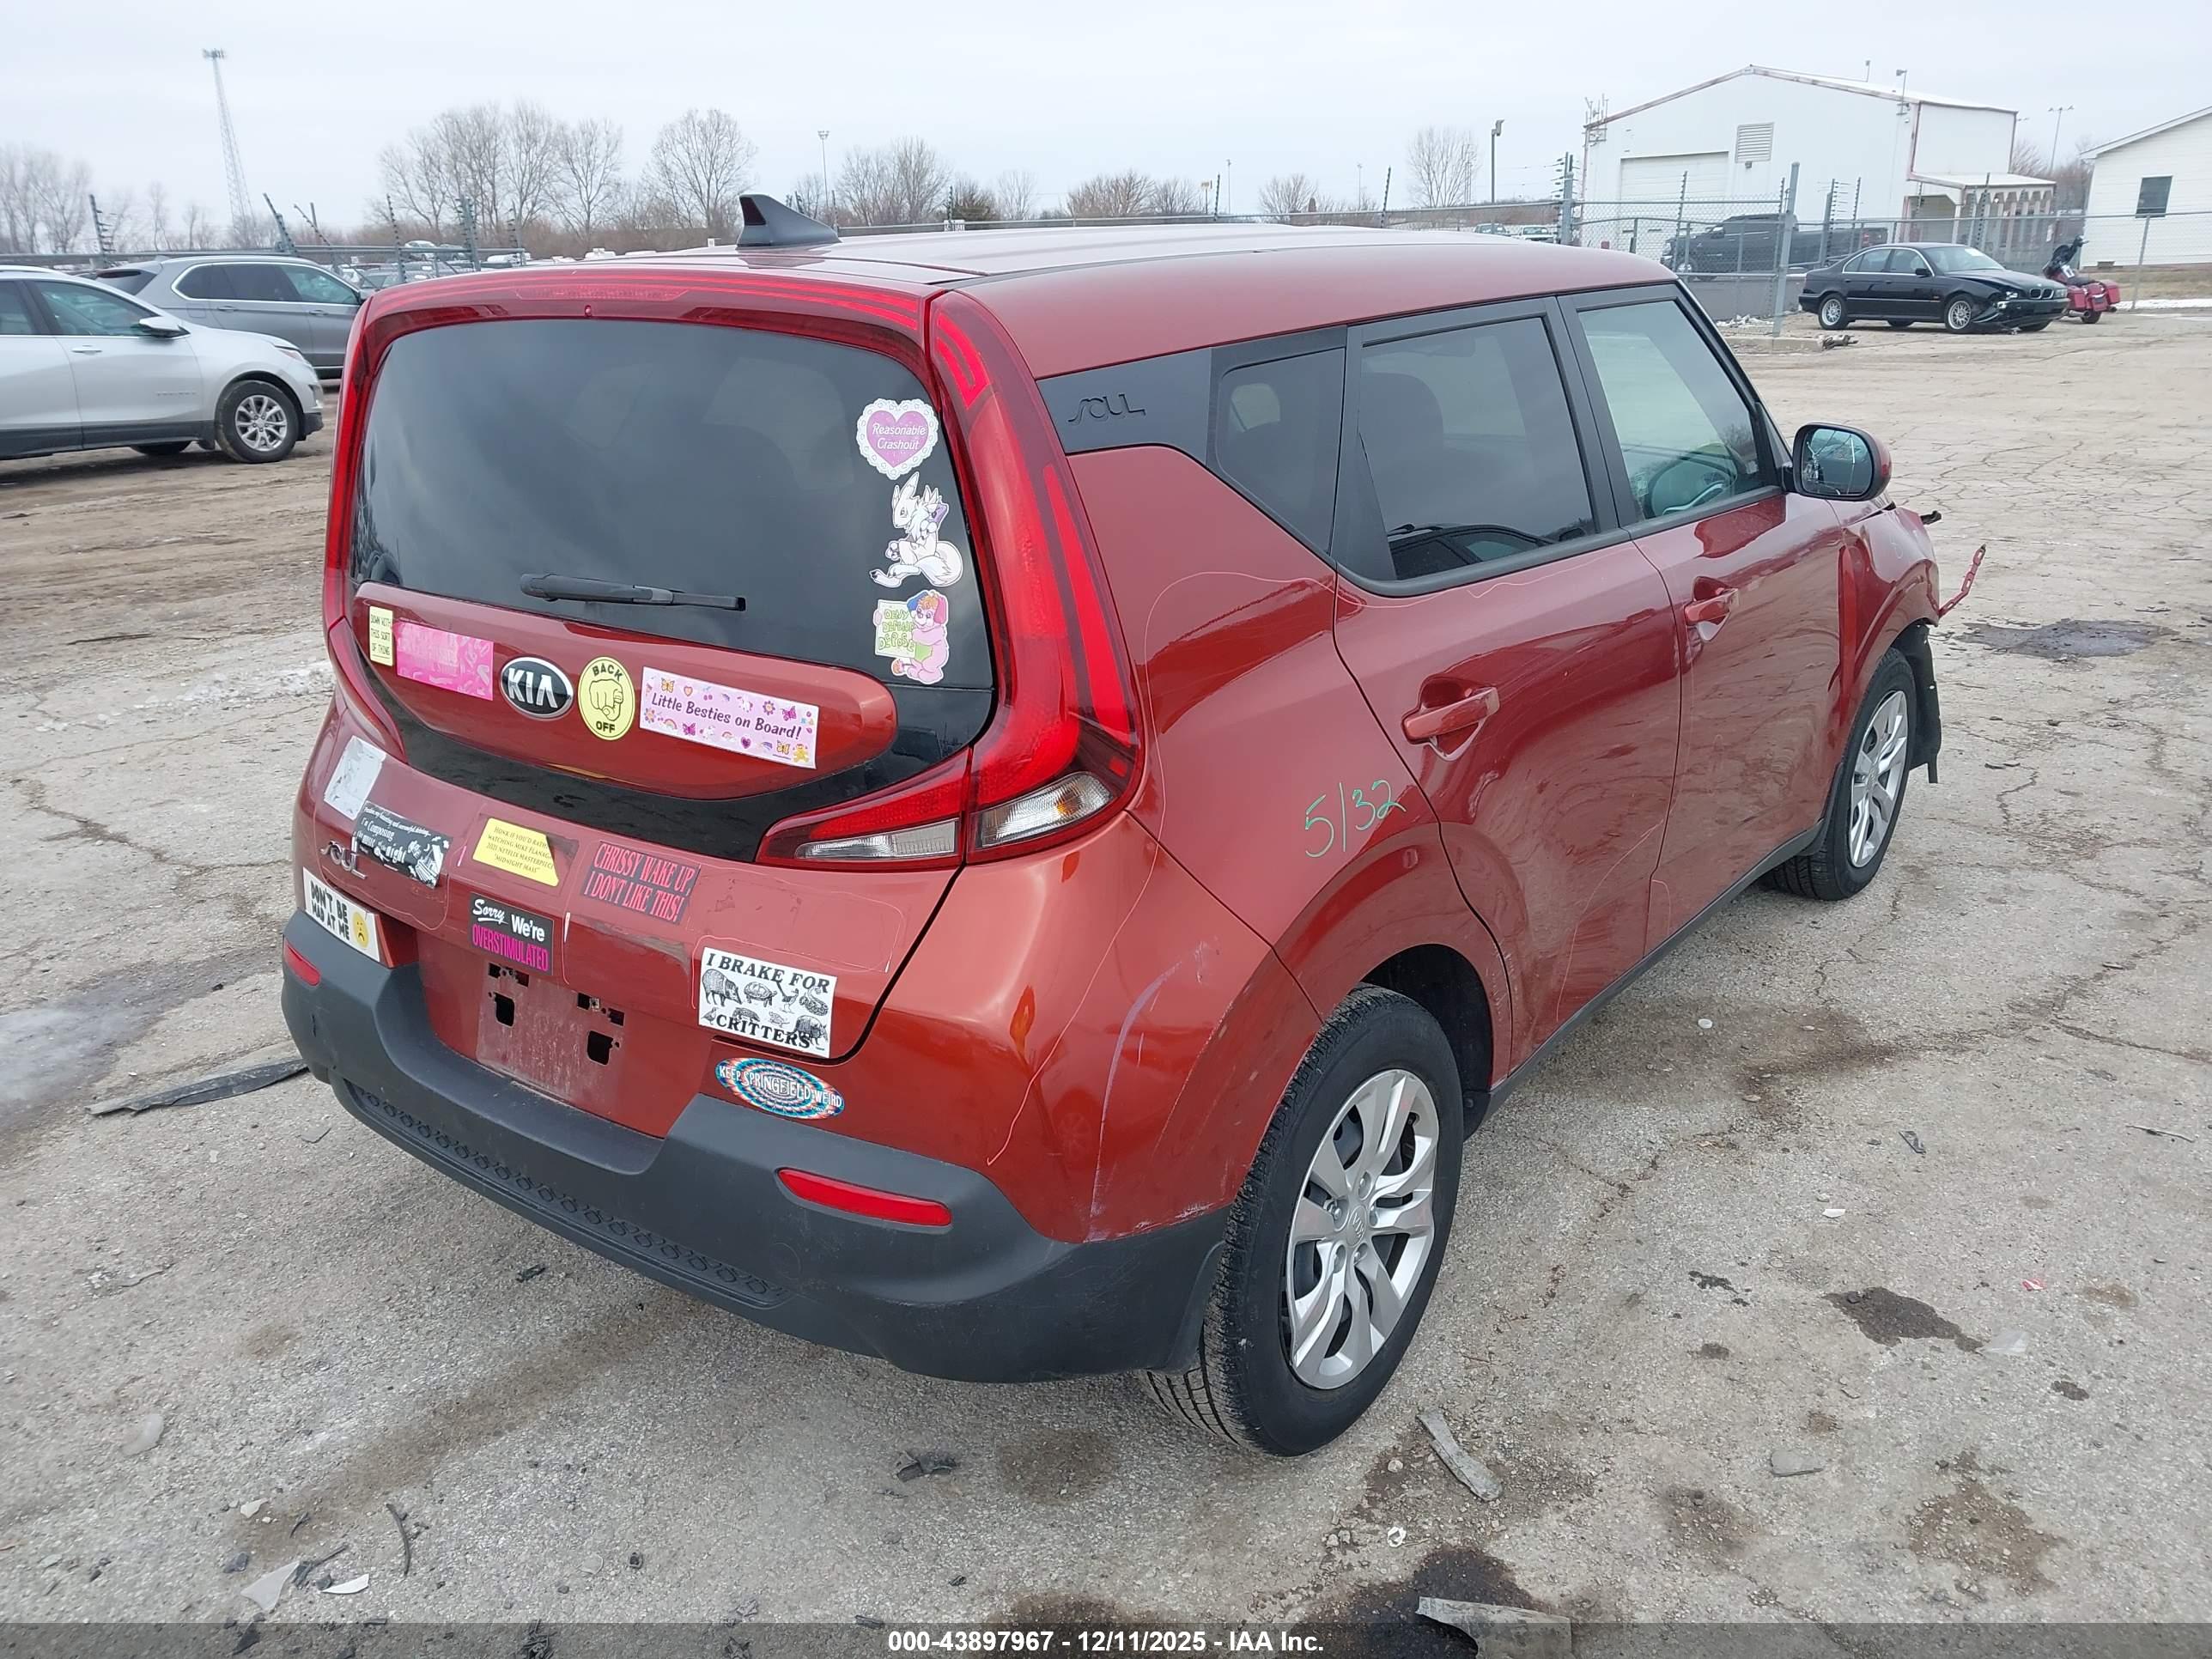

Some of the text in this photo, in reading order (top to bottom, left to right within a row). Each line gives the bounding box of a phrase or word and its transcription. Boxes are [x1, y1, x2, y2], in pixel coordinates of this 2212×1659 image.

[1067, 393, 1146, 423] SOUL
[872, 422, 927, 435] Reasonable
[877, 437, 920, 450] Crashout
[884, 609, 909, 620] DENY
[878, 632, 915, 652] DEPOSE
[507, 667, 558, 708] KIA
[592, 662, 623, 682] BACK
[596, 720, 616, 733] OFF
[651, 692, 802, 740] Little Besties on Board!
[368, 820, 395, 842] Composing
[488, 834, 514, 847] WATCHING
[514, 842, 528, 852] MIKE
[494, 825, 508, 837] HONK
[515, 834, 532, 845] YOU'D
[532, 838, 548, 848] RATH
[320, 835, 367, 879] SOUL
[362, 835, 375, 848] music
[386, 843, 407, 864] night
[486, 842, 498, 851] 2021
[499, 847, 519, 858] NETFLIX
[593, 842, 696, 896] CHRISSY WAKE UP,
[311, 879, 348, 925] DON'T BE
[584, 871, 595, 895] I
[622, 881, 653, 912] LIKE
[649, 890, 684, 922] THIS!
[312, 900, 349, 941] MAD AT ME
[472, 898, 545, 942] Sorry We're
[472, 923, 549, 972] OVERSTIMULATED
[707, 953, 830, 994] I BRAKE FOR
[716, 1014, 811, 1048] CRITTERS
[720, 1065, 842, 1108] KEEP SPRINGFIELD WEIRD
